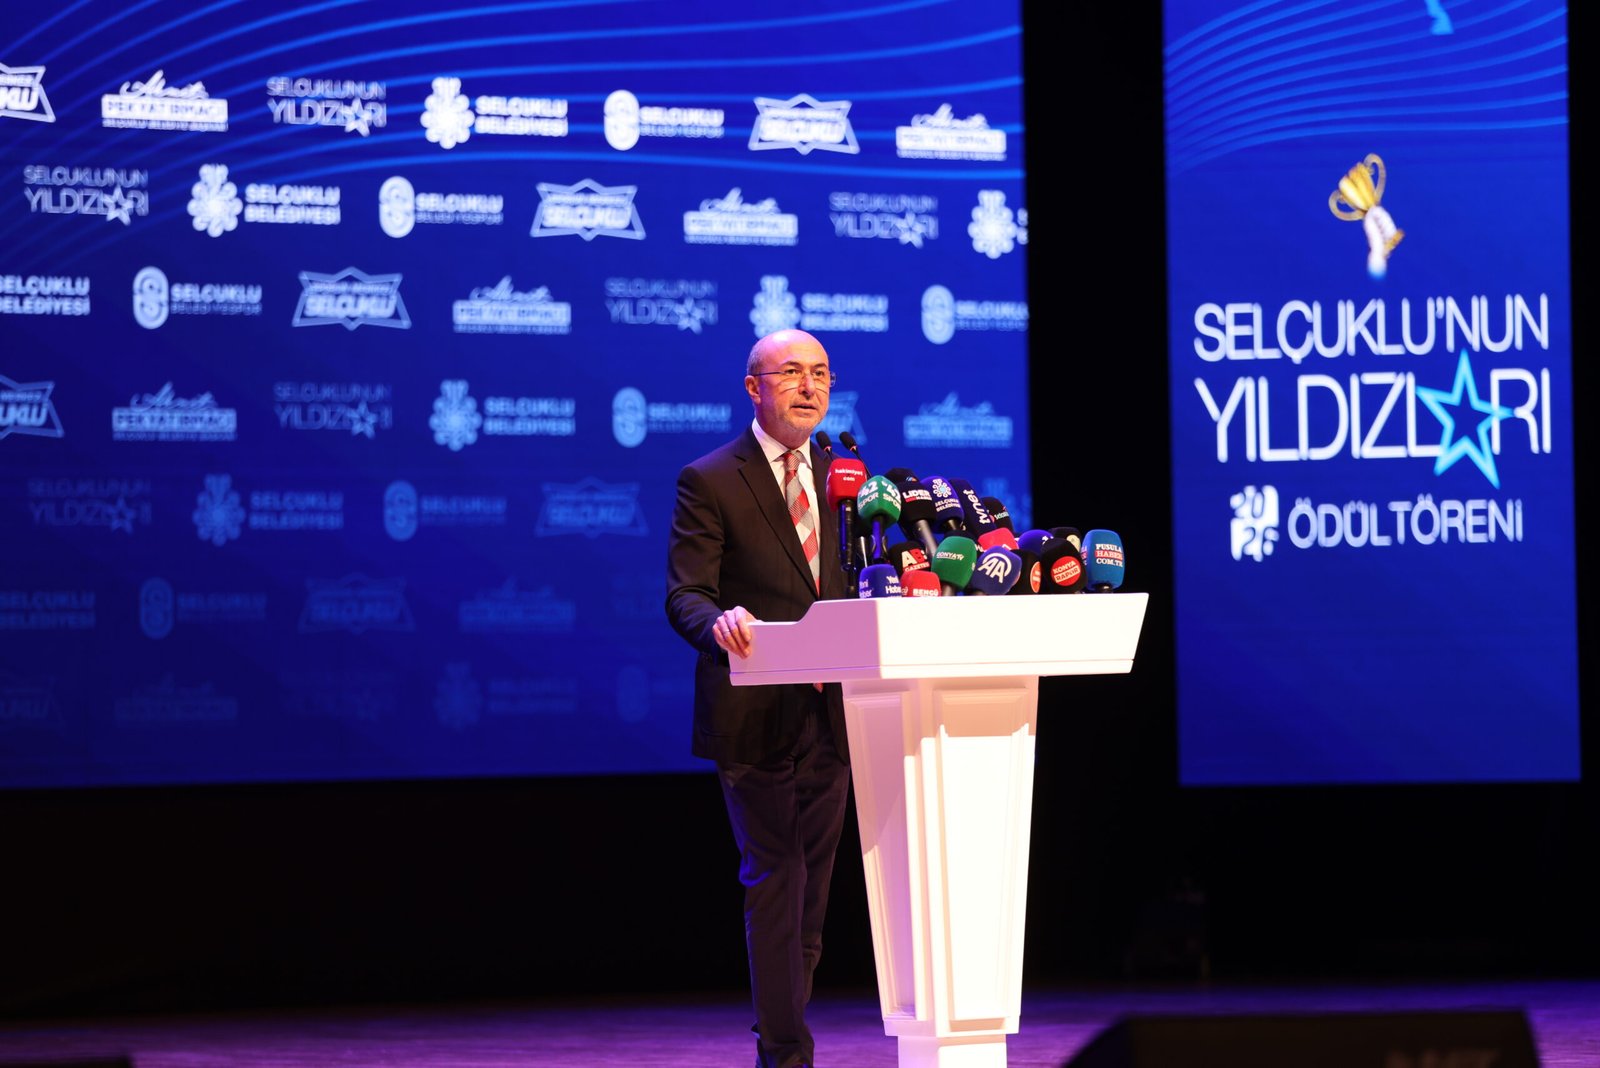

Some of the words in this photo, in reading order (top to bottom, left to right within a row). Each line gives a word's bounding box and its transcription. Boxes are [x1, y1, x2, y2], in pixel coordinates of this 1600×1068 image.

[1194, 293, 1549, 364] SELÇUKLU'NUN
[1287, 497, 1391, 549] ÖDÜL
[1388, 494, 1524, 546] TÖRENİ
[1095, 544, 1122, 553] PUSULA
[978, 558, 1006, 584] AA
